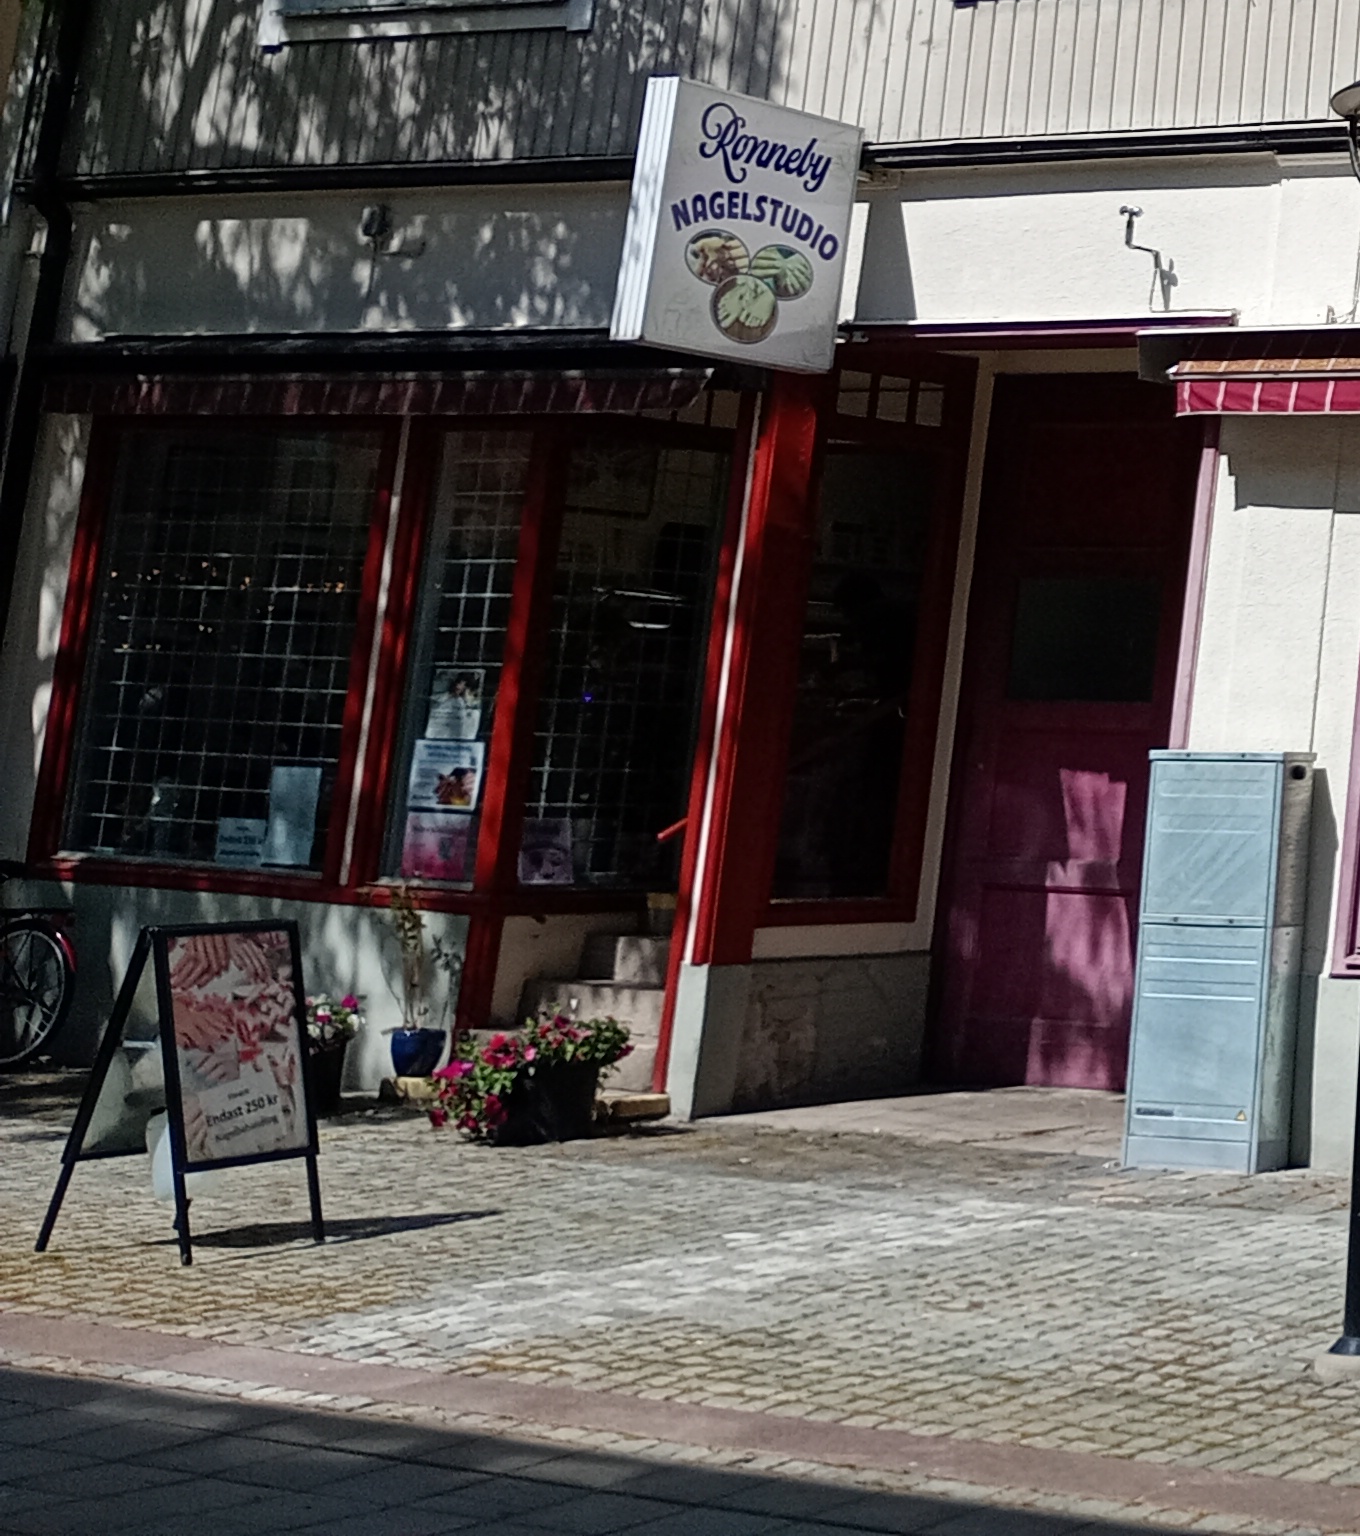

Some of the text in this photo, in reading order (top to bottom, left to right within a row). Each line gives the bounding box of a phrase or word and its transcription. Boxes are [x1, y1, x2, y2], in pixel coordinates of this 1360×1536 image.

[699, 102, 832, 192] Ronneby
[671, 191, 839, 260] NAGELSTUDIO
[205, 1106, 243, 1127] Endast
